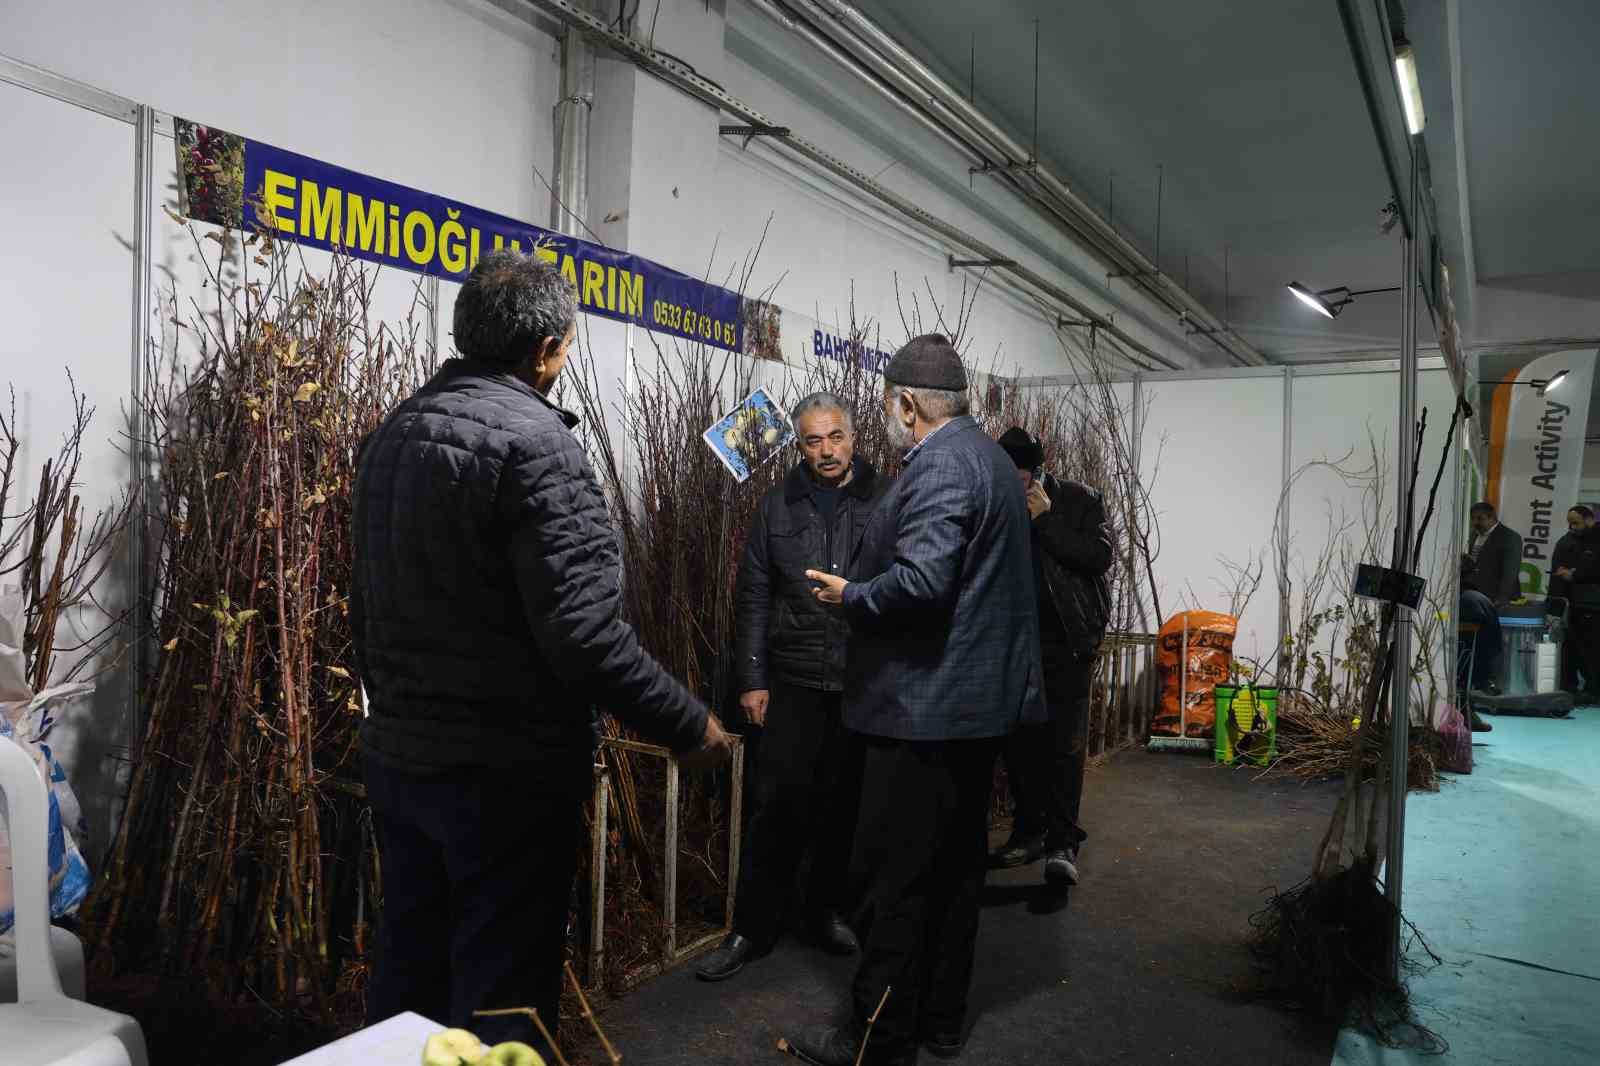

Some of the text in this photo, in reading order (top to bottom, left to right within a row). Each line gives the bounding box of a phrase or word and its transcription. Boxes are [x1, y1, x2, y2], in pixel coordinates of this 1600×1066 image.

[653, 299, 682, 329] 0533
[683, 309, 697, 336] 63
[714, 319, 721, 342] 0
[1523, 400, 1570, 560] Plant Activity
